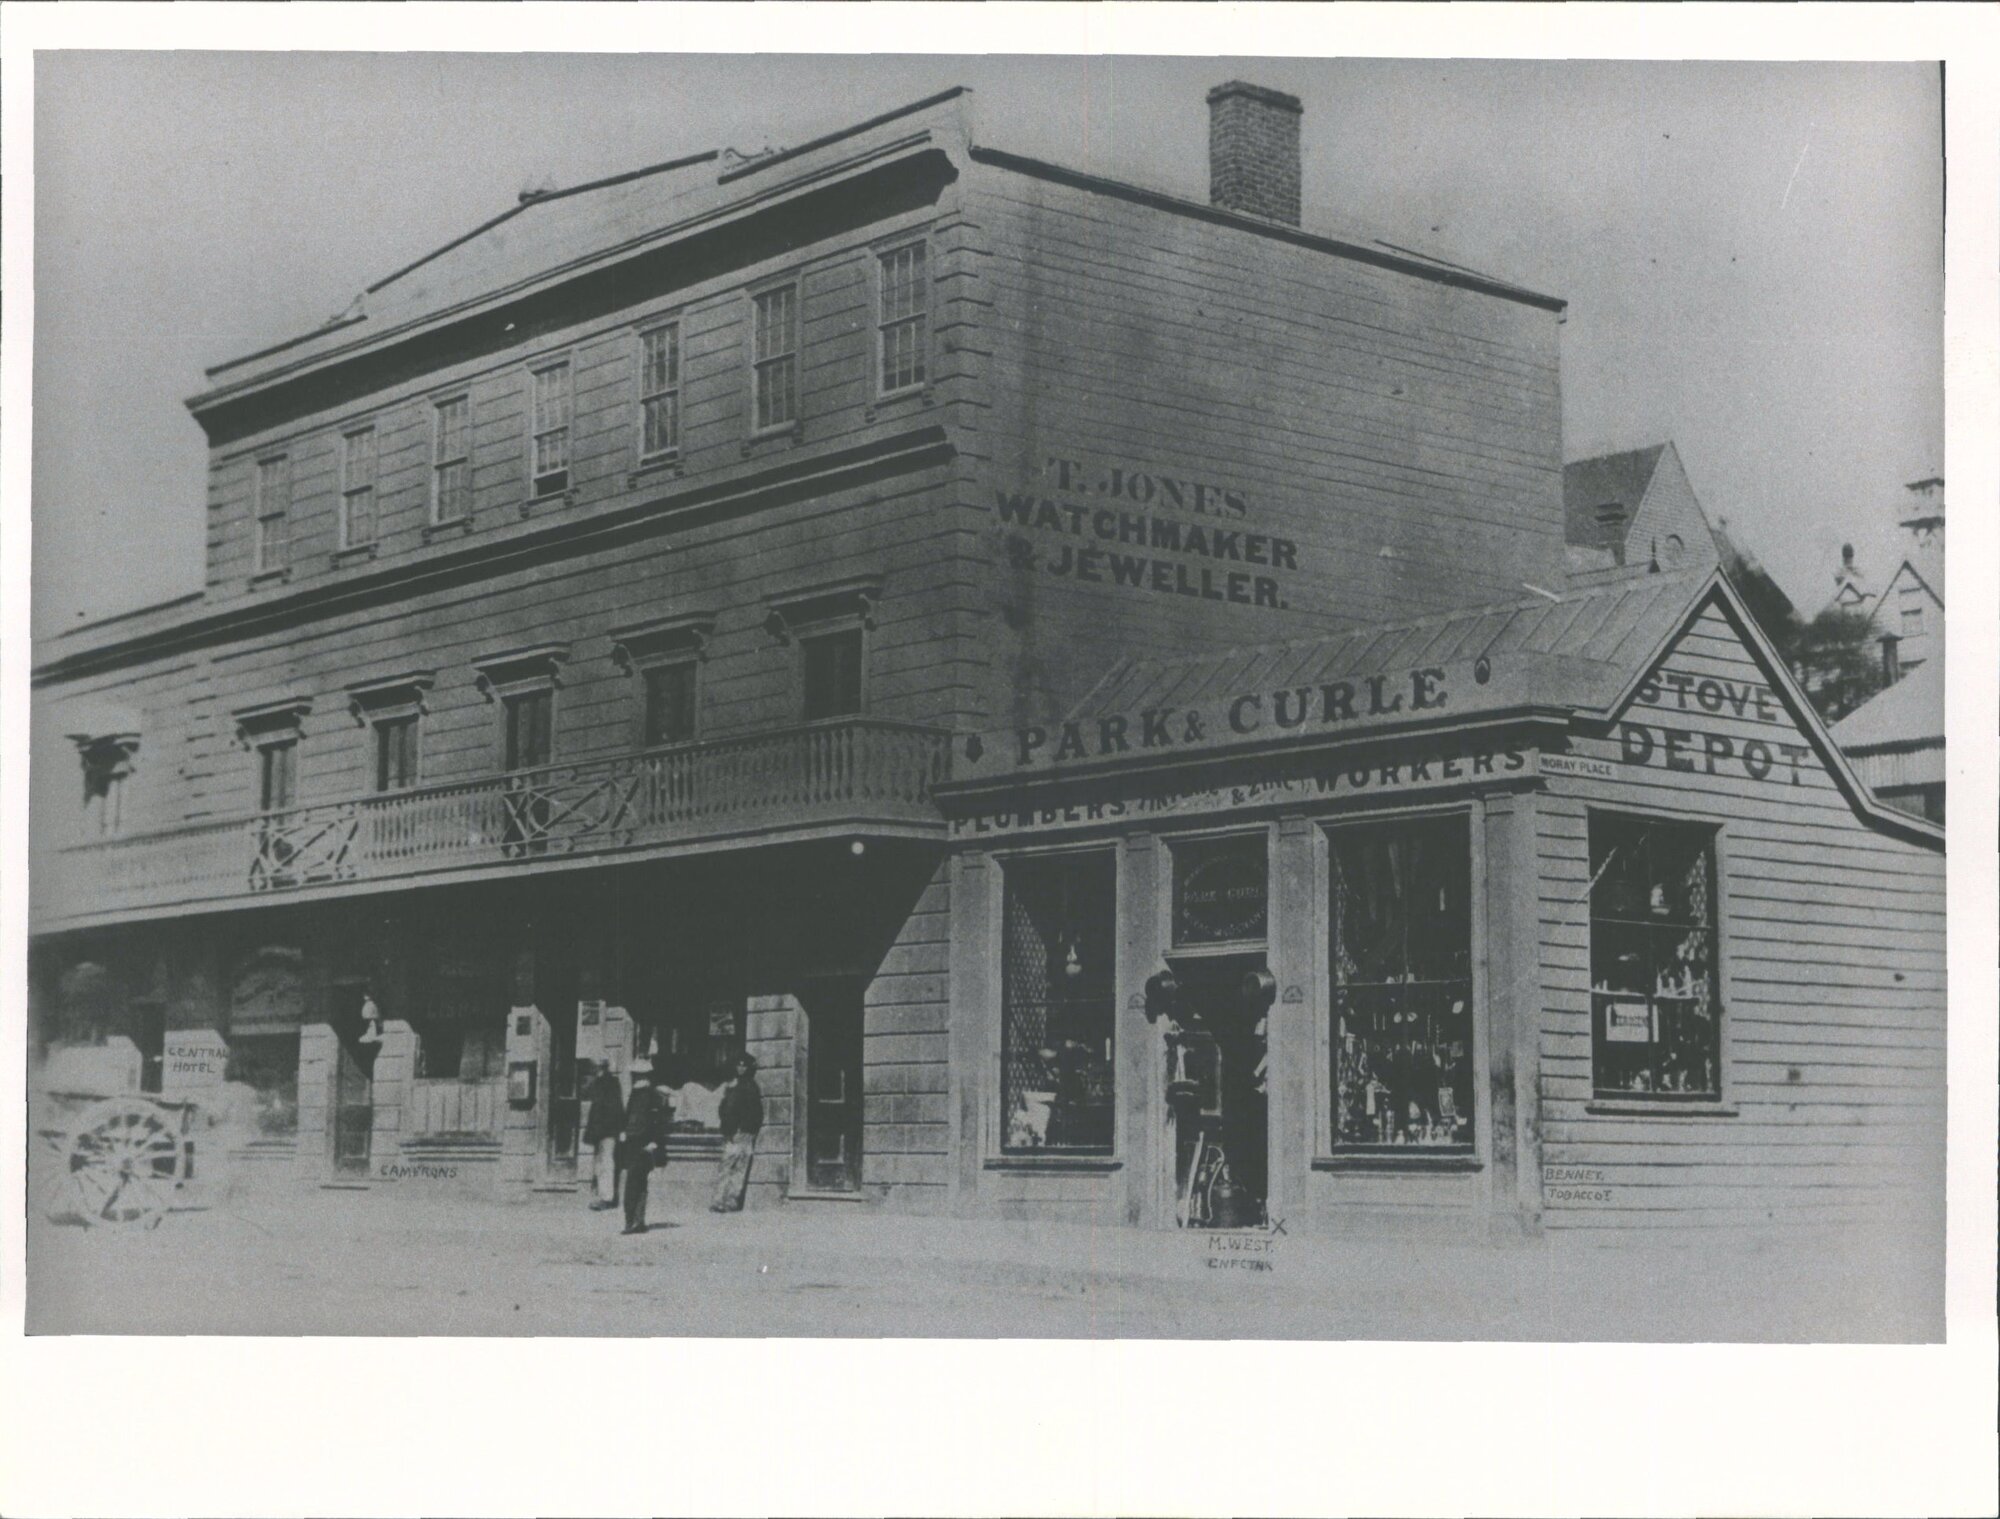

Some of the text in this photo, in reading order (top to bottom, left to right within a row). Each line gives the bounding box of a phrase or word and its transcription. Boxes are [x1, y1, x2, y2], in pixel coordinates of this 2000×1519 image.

[1047, 456, 1247, 521] T. JONES
[995, 490, 1299, 571] WATCHMAKER
[1007, 533, 1289, 609] & JEWELLER.
[1016, 666, 1450, 766] PARK & CURLE
[1635, 671, 1778, 722] STOVE
[1231, 787, 1246, 806] &
[1312, 751, 1525, 794] WORKERS
[1541, 757, 1612, 776] MORAY PLACE
[1618, 724, 1810, 786] DEPOT
[167, 1046, 229, 1059] CENTRAL
[172, 1061, 217, 1074] HOTEL
